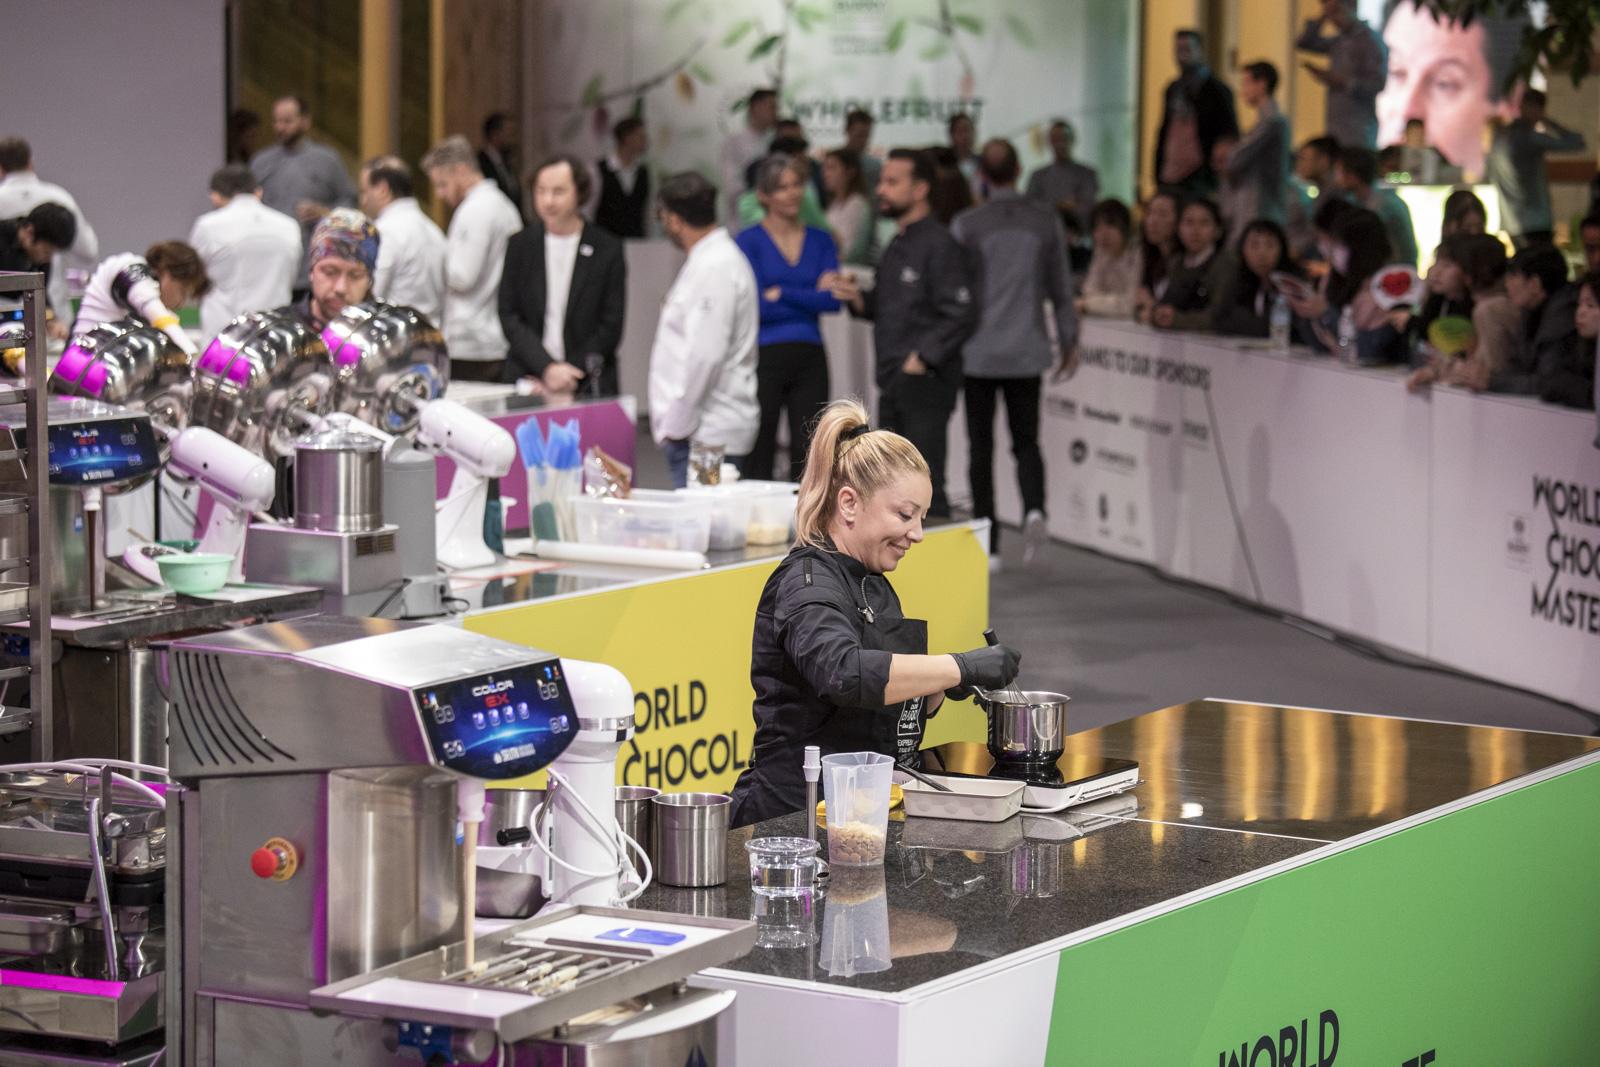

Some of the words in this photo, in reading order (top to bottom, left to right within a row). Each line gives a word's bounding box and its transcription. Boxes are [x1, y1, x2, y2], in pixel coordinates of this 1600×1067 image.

[471, 679, 514, 697] COLOR
[484, 694, 510, 708] EX
[634, 680, 706, 734] ORLD
[623, 730, 755, 788] CHOCOL
